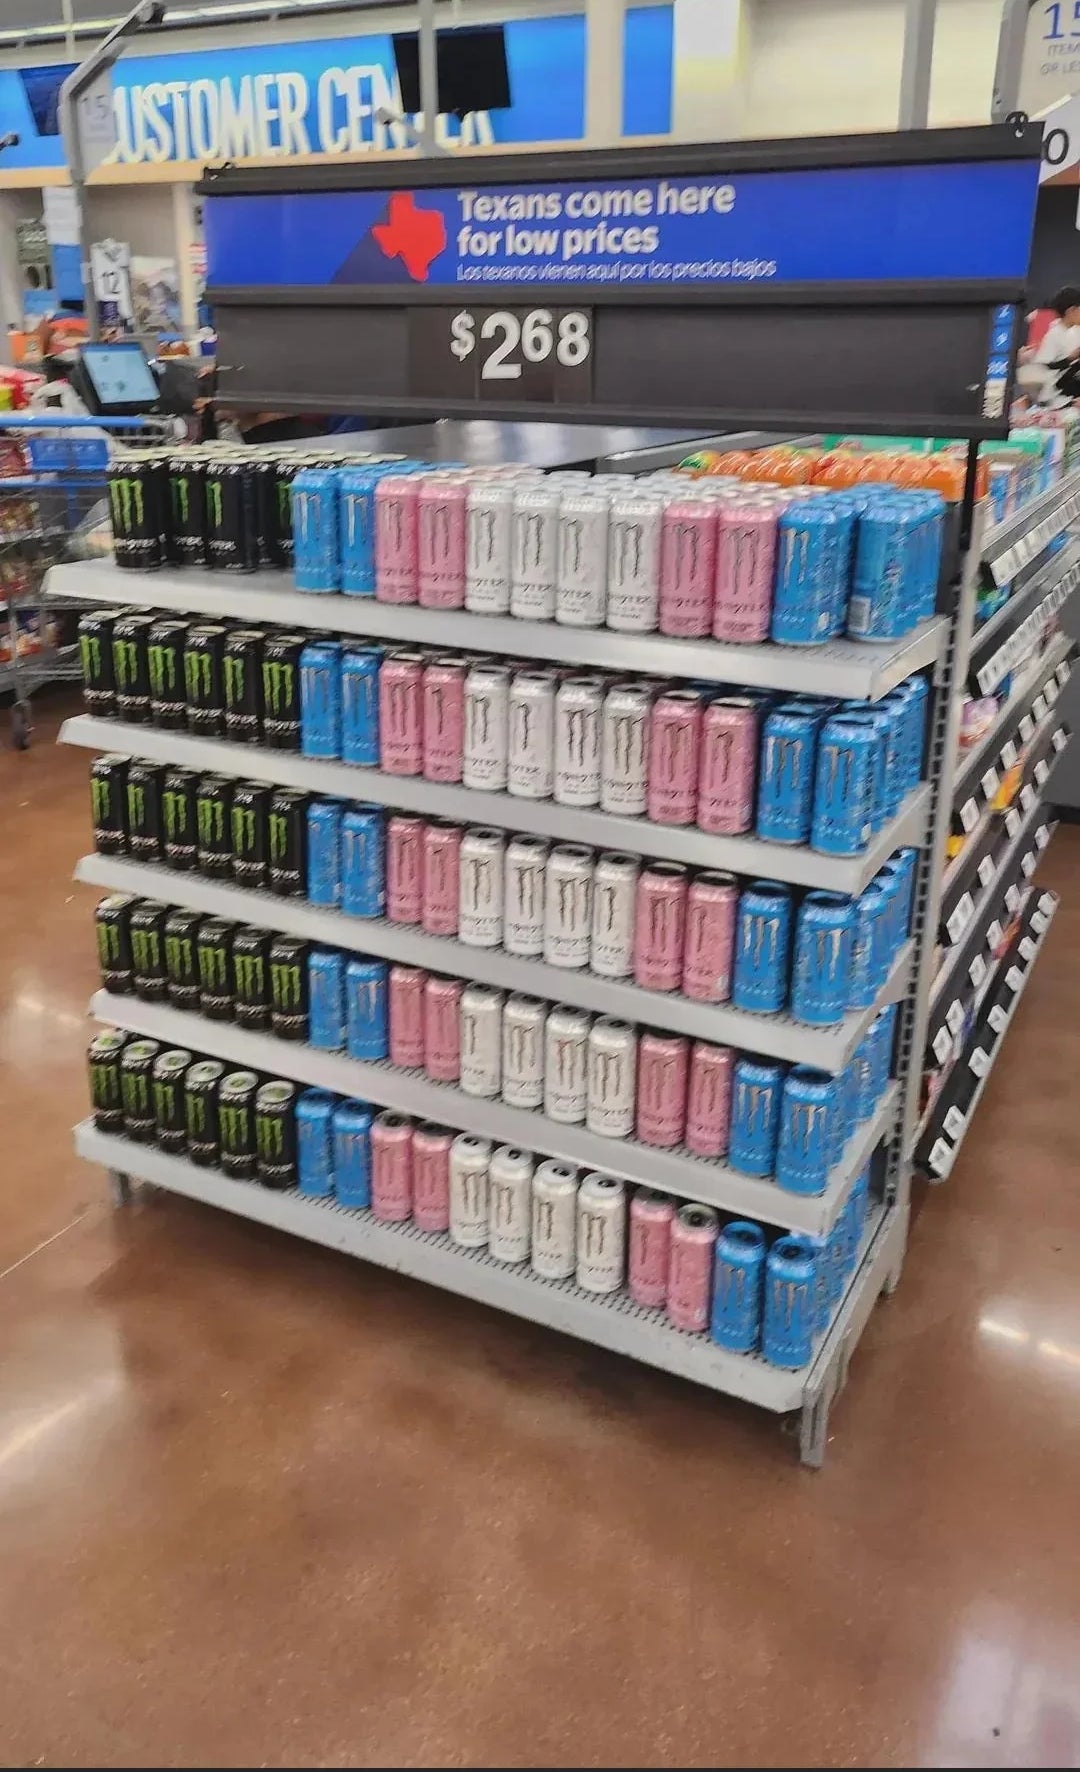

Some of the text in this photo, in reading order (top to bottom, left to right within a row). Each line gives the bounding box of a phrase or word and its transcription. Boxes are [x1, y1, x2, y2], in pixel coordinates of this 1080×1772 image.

[102, 72, 312, 163] USTOMER
[457, 181, 736, 222] Texans come here
[457, 220, 659, 261] for low prices
[457, 263, 482, 281] Los
[482, 263, 538, 281] texanos
[620, 262, 647, 282] por
[648, 260, 672, 280] los
[731, 257, 777, 281] bajos
